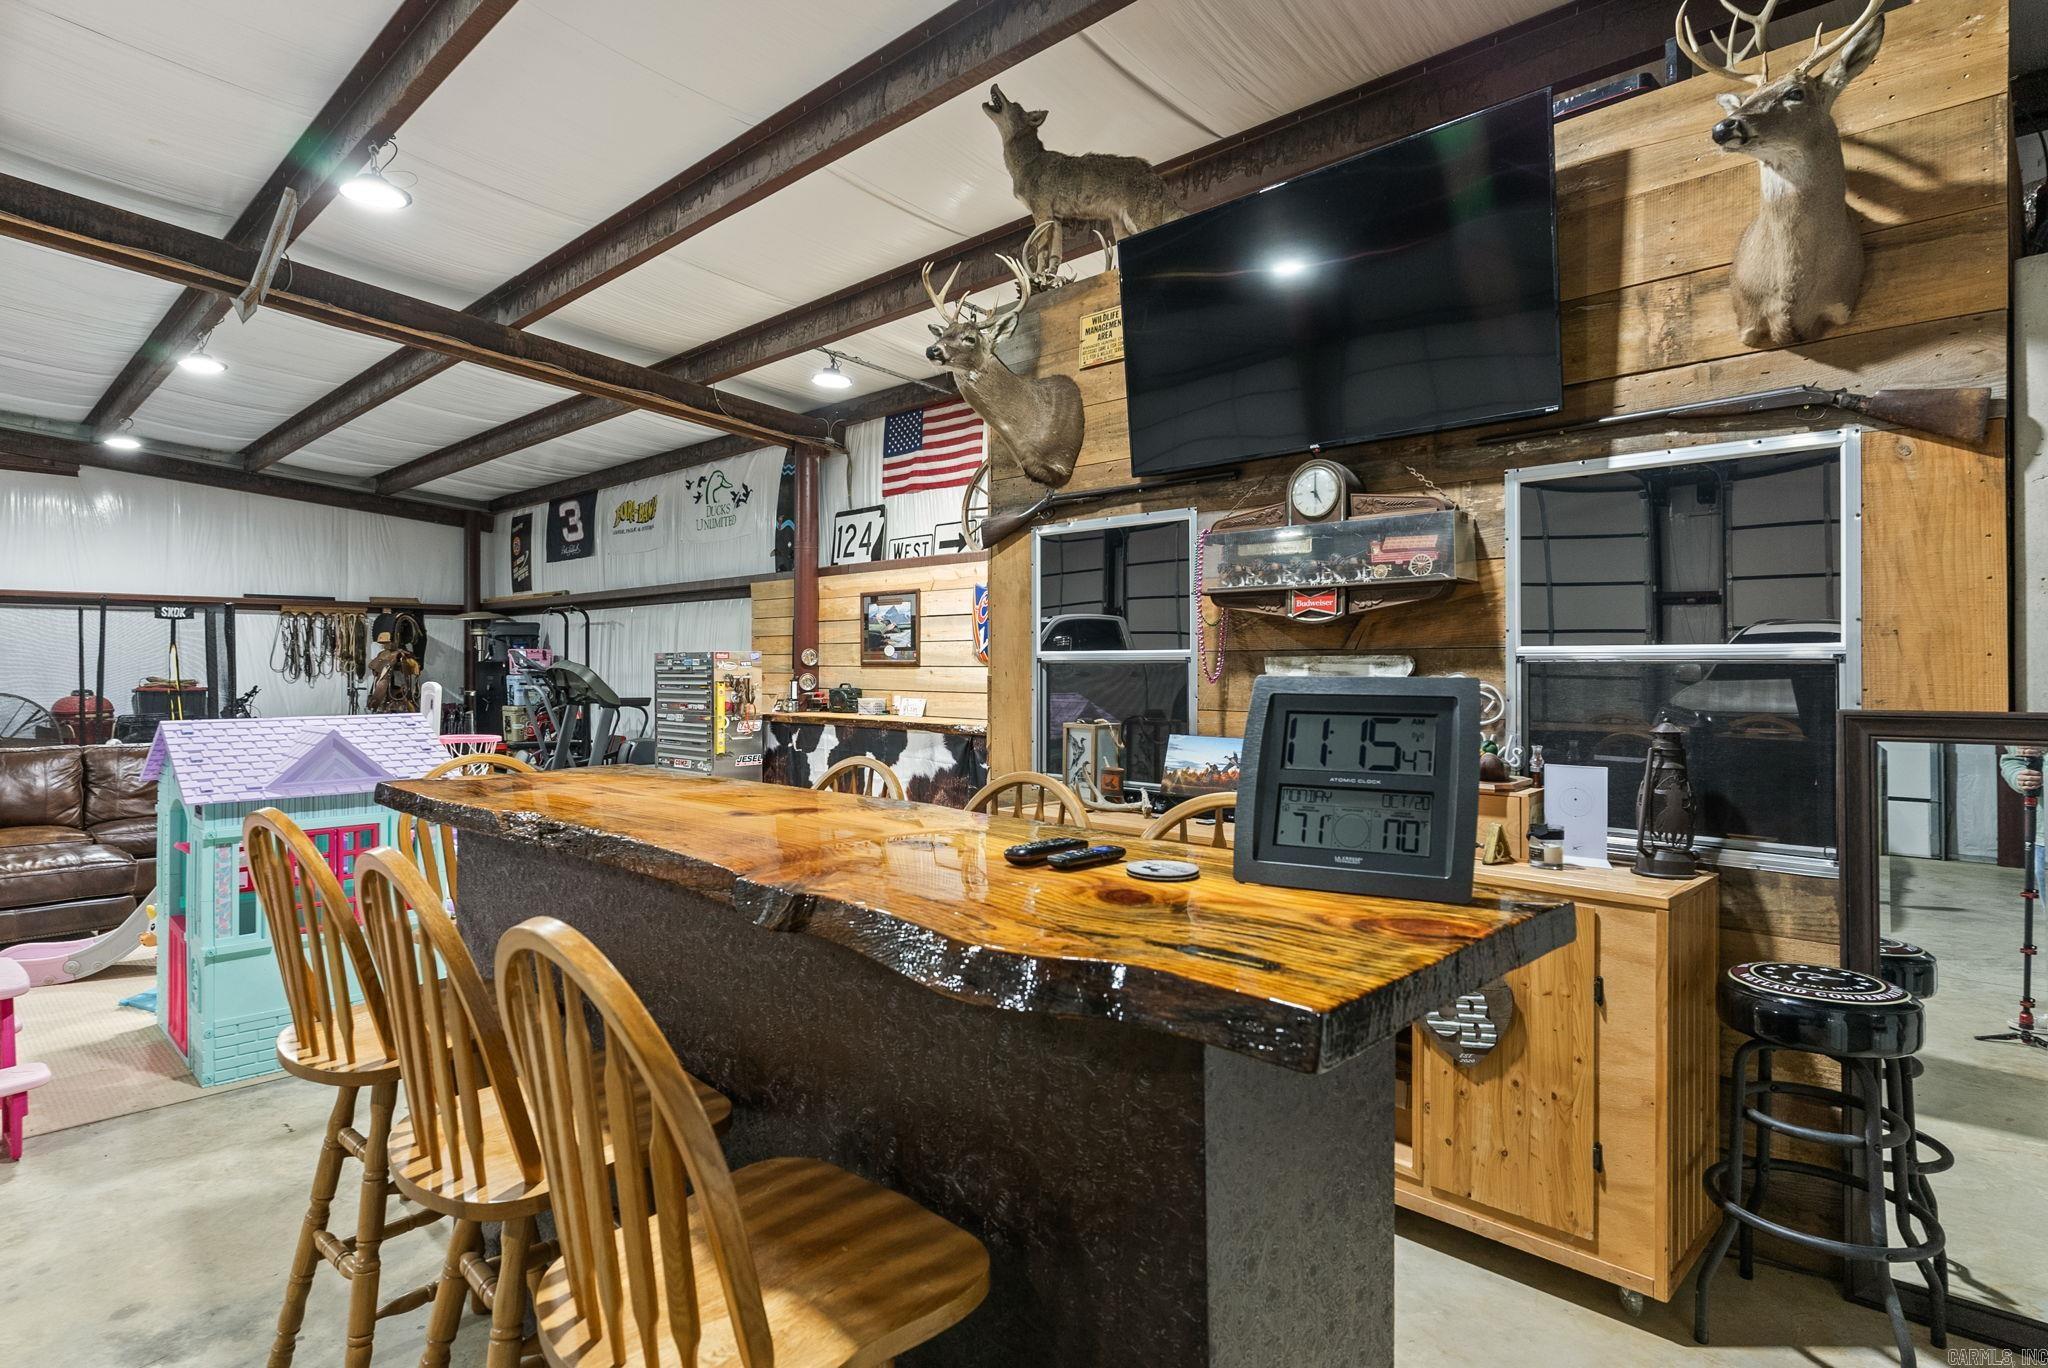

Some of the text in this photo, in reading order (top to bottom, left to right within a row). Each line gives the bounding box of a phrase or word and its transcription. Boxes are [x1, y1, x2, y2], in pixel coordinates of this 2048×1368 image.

[1085, 319, 1122, 336] MANAGEMEN
[1092, 310, 1119, 325] WILDLIFE
[1097, 330, 1113, 341] AREA
[559, 500, 584, 542] 3
[706, 503, 731, 518] DUCKS
[696, 515, 737, 531] UNLIMITED
[836, 521, 872, 559] 124
[893, 541, 930, 560] WEST
[1287, 717, 1402, 772] 11:15
[737, 754, 762, 763] JESEL
[1403, 750, 1432, 772] 47
[1282, 788, 1430, 811] MONDAY OCT/20
[1293, 812, 1325, 844] 71
[1383, 819, 1420, 853] 70
[1740, 972, 1807, 994] WETLAND
